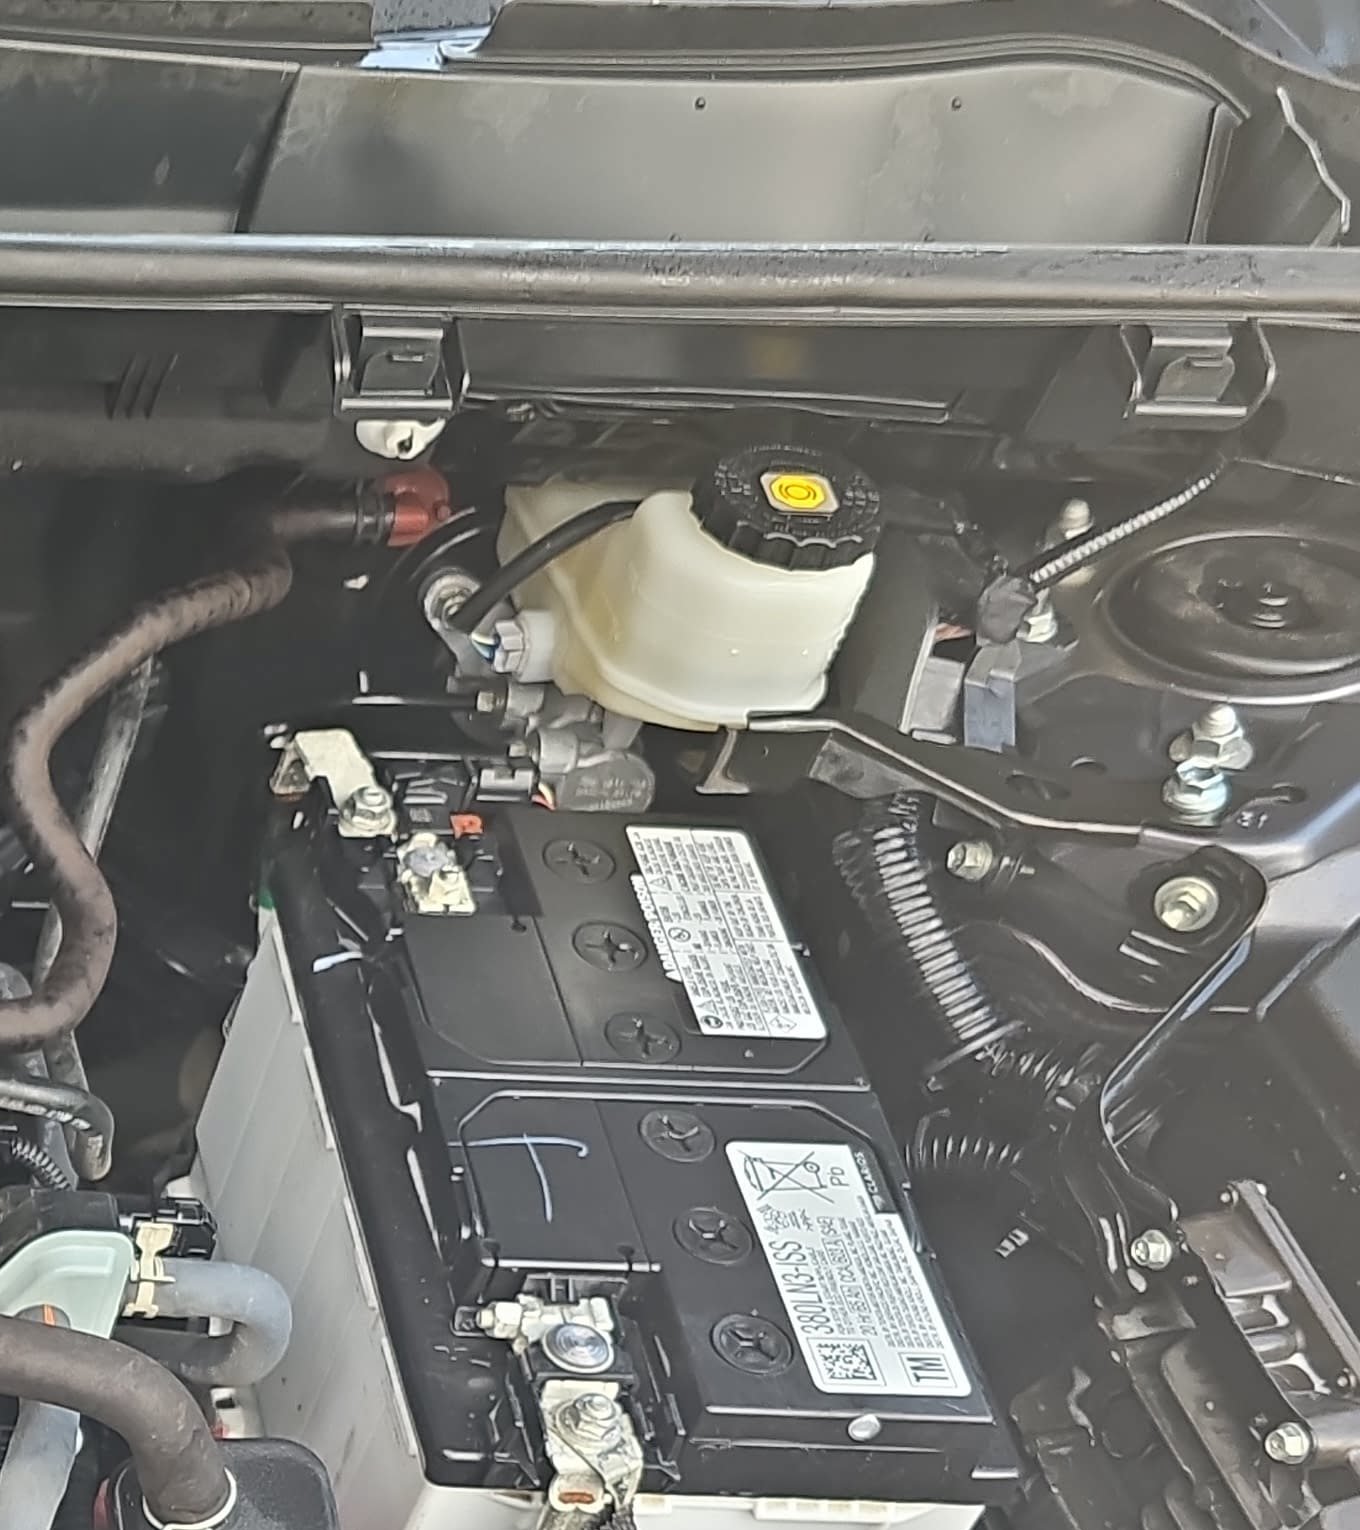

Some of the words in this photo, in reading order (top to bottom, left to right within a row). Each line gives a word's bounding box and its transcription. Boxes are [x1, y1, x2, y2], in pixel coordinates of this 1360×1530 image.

[823, 1166, 851, 1186] Pb
[766, 1239, 835, 1334] 380LN3-ISS
[909, 1357, 949, 1383] TM
